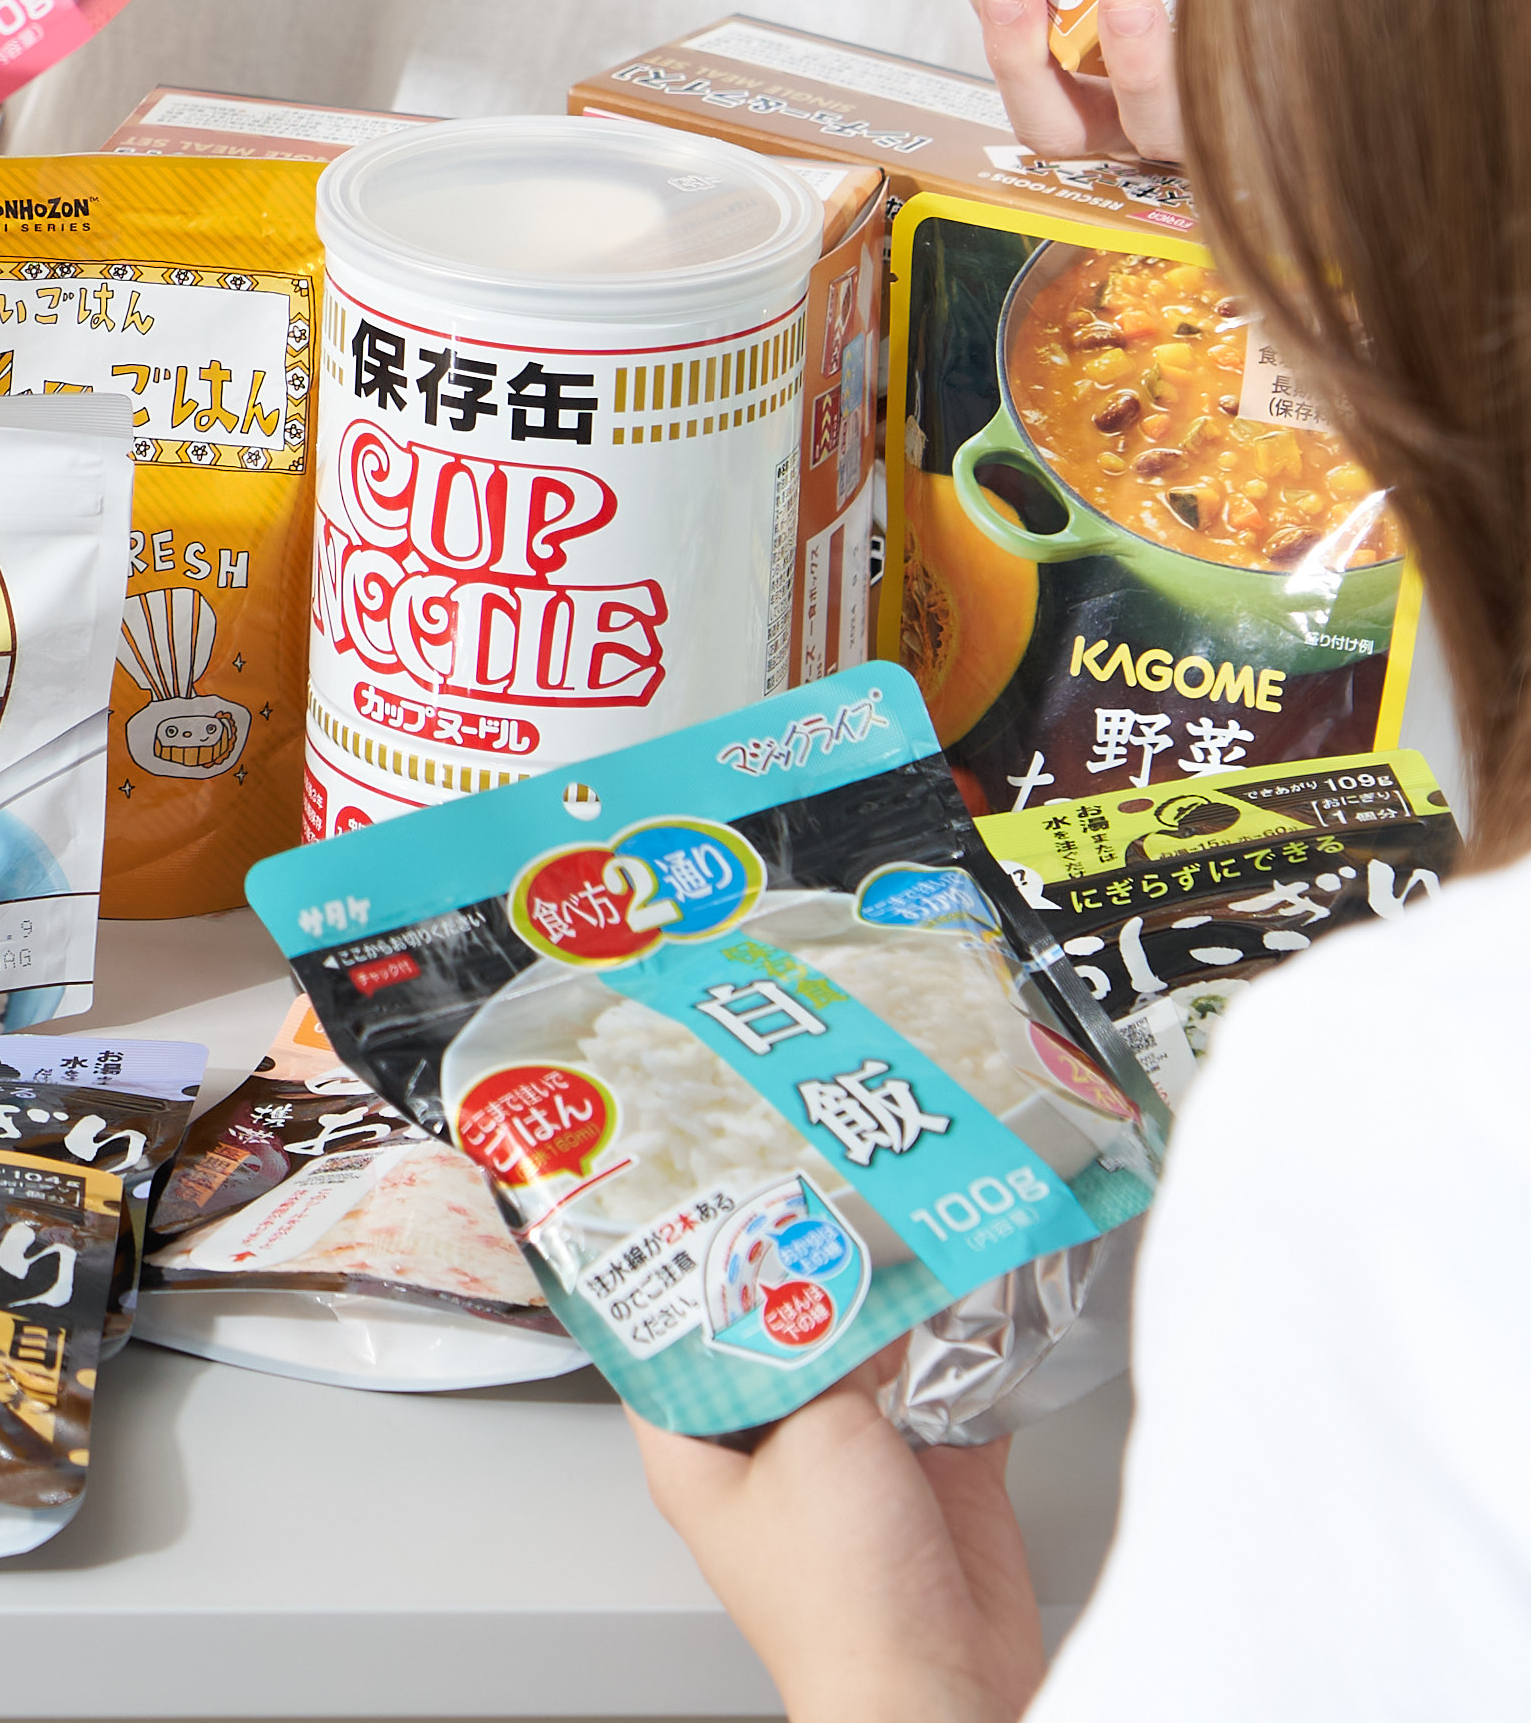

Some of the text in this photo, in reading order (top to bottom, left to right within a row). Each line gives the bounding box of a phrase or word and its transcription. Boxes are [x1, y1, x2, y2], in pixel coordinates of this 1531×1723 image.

[21, 221, 93, 234] SERIES
[350, 317, 601, 447] 保存缶
[337, 417, 618, 585] CUP
[312, 522, 667, 708] NOODLE
[1303, 631, 1375, 656] 盛り付け例
[1069, 633, 1288, 714] KAGOME
[359, 684, 533, 752] カップヌードル
[717, 692, 885, 777] マジックライス
[1086, 706, 1256, 788] 野菜
[1242, 770, 1395, 800] できあがり 109g
[1321, 789, 1394, 811] おにぎり
[1069, 833, 1347, 915] にぎらずにできる
[1075, 804, 1119, 865] お湯または
[531, 843, 734, 946] 食べ方2通り
[698, 976, 950, 1167] 白飯
[586, 1190, 738, 1300] 注水線が2本ある
[909, 1166, 1052, 1243] 100g
[610, 1250, 699, 1323] のでご注意
